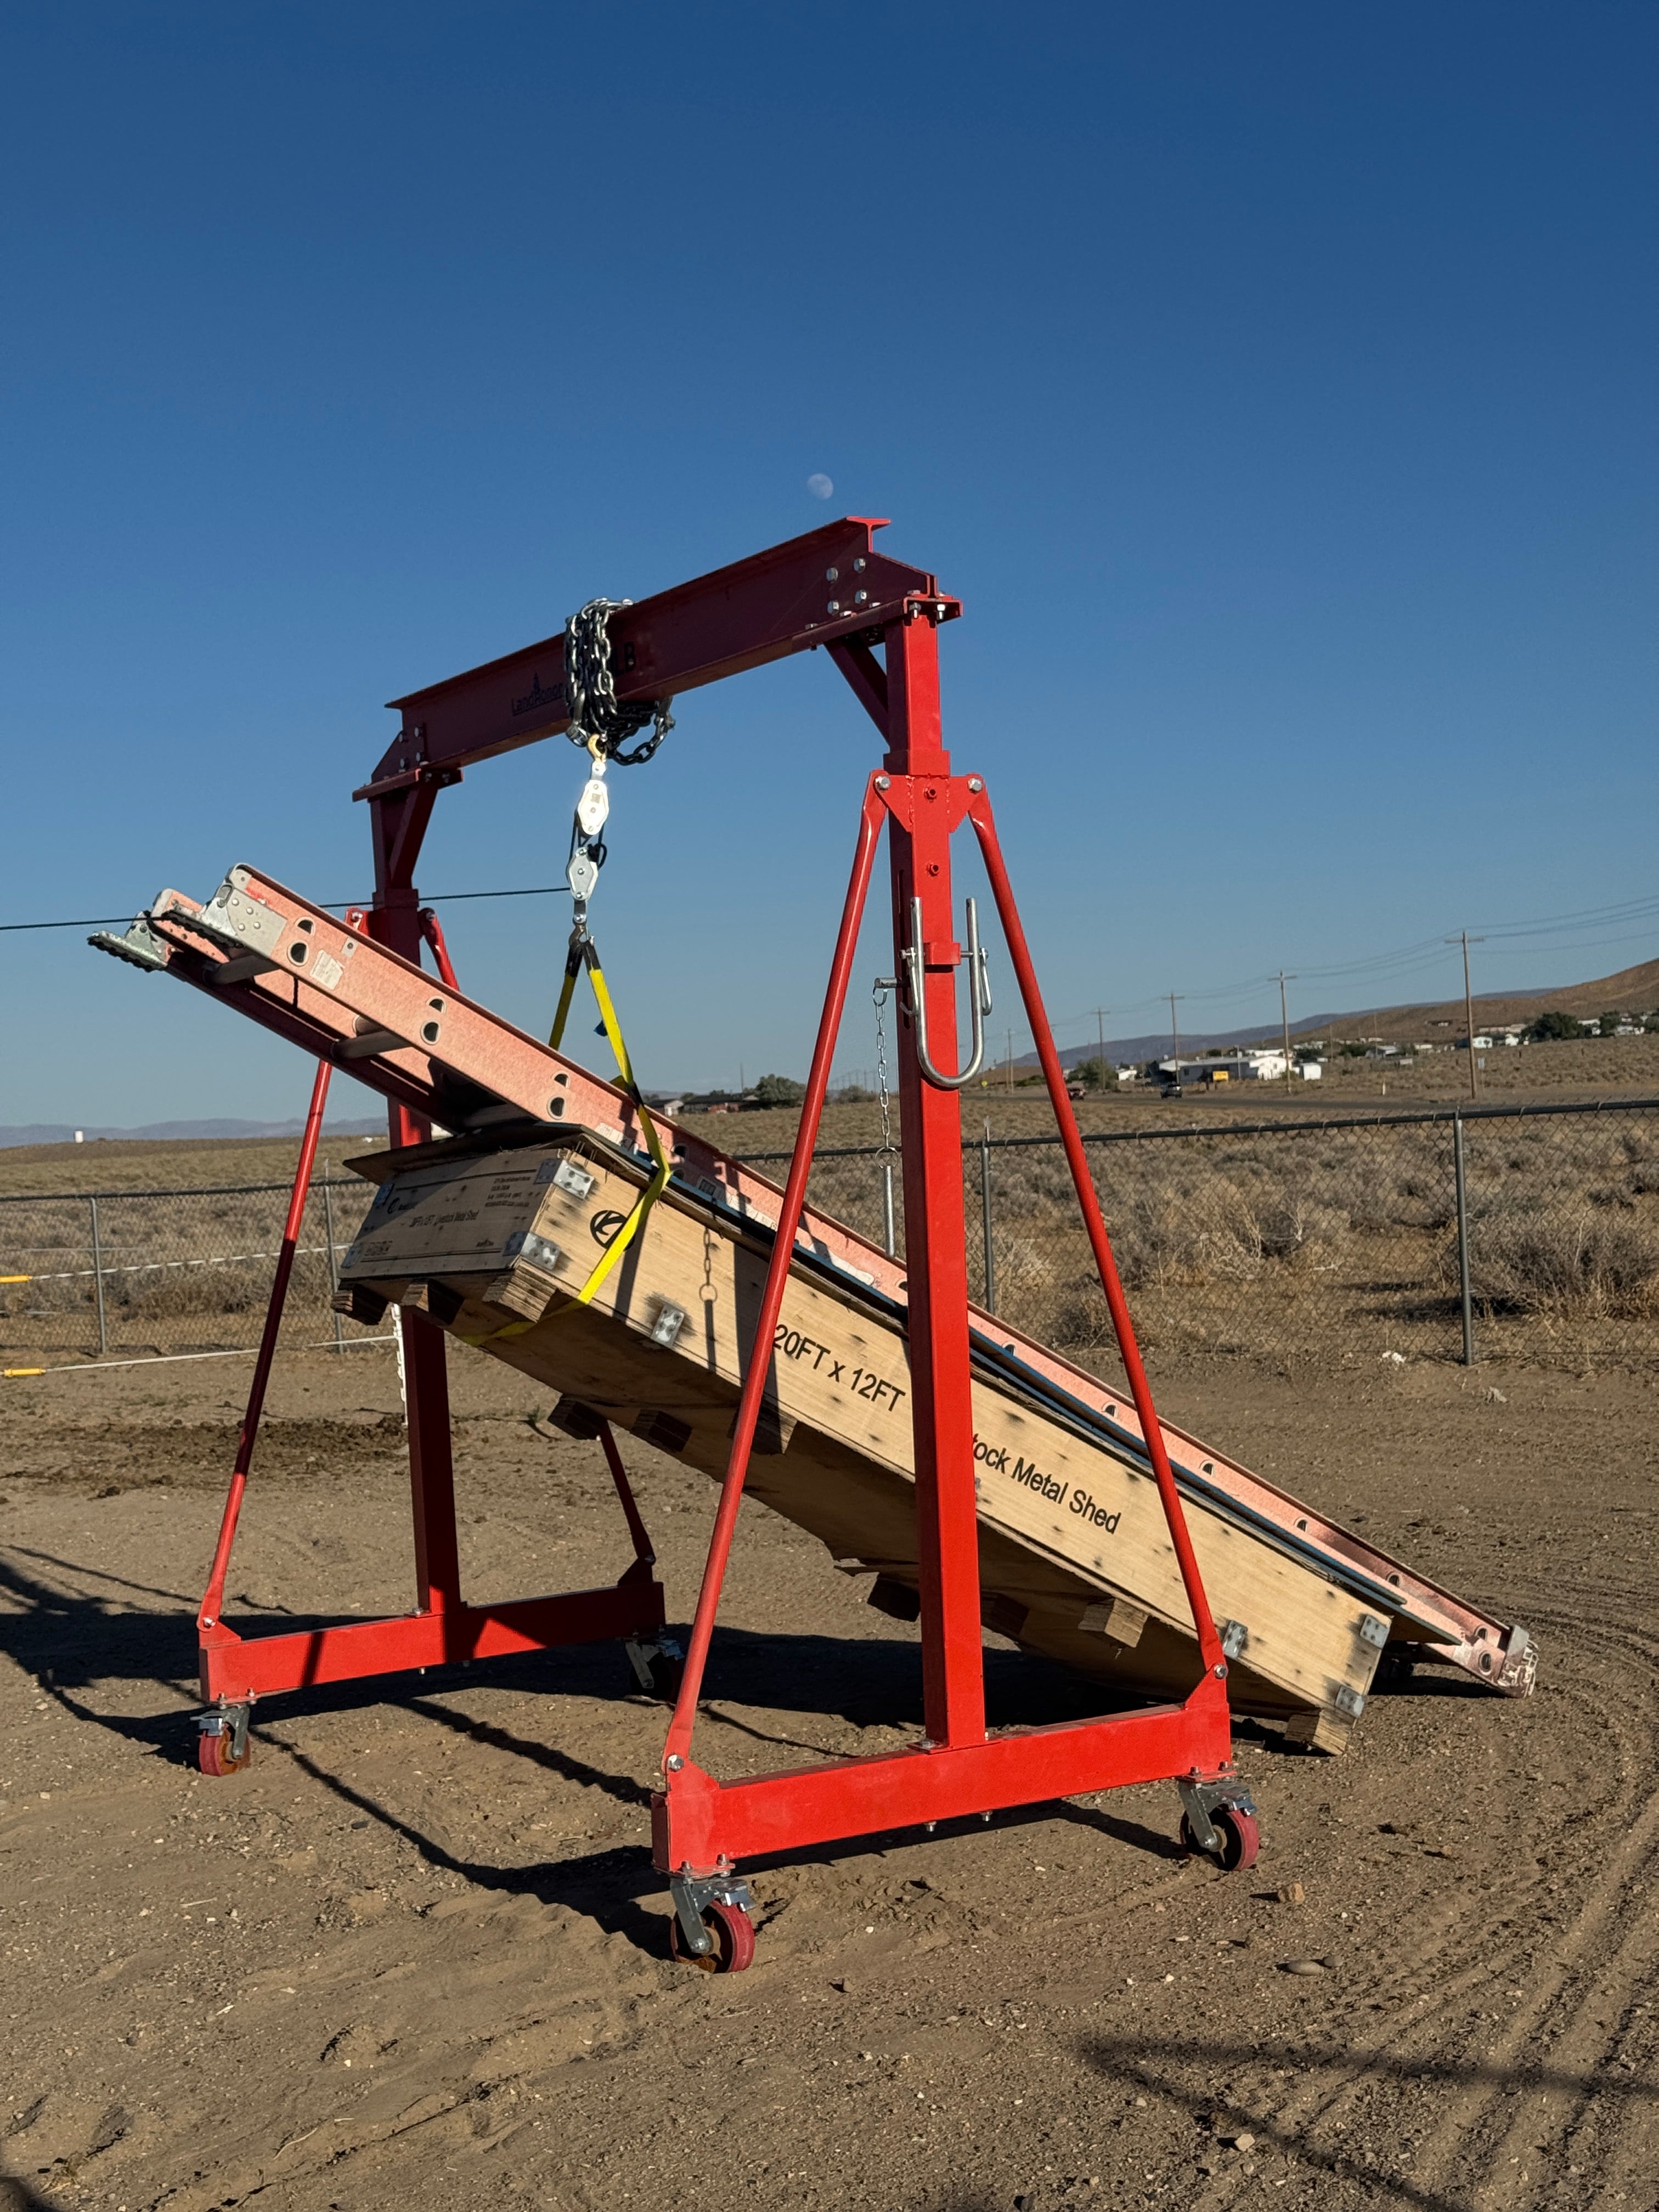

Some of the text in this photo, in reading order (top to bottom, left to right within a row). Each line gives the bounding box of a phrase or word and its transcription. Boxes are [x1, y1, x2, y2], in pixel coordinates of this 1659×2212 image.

[772, 1324, 831, 1370] 20FT
[827, 1360, 846, 1383] x
[850, 1368, 906, 1412] 12FT
[1011, 1456, 1069, 1504] Metal
[1069, 1489, 1121, 1535] Shed
